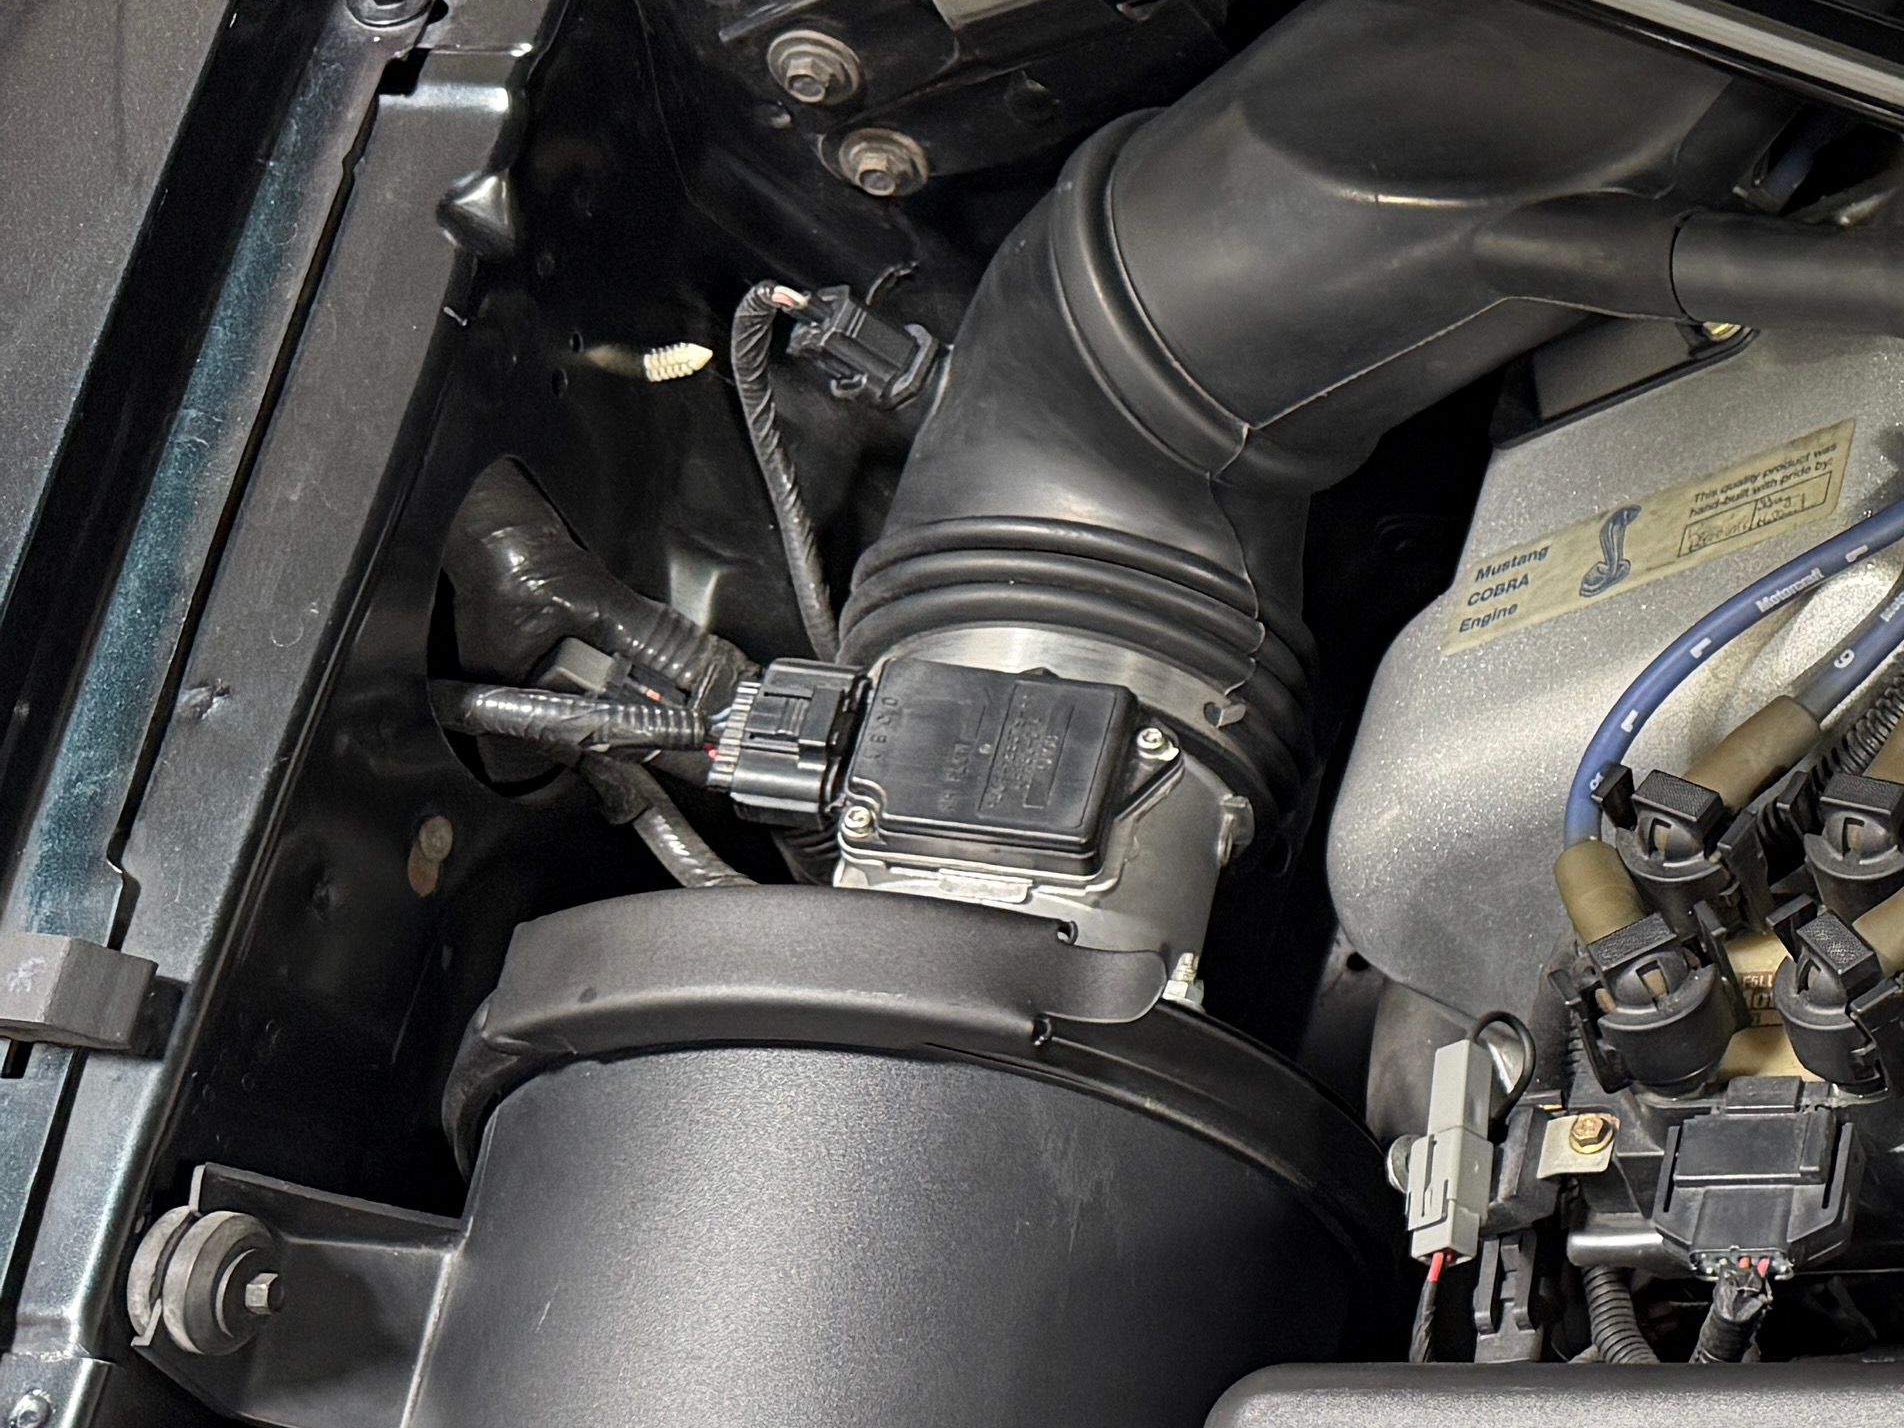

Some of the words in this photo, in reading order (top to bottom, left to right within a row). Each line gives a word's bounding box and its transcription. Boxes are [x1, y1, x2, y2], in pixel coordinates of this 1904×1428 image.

[1720, 471, 1760, 496] quality
[1761, 454, 1811, 483] product
[1812, 442, 1838, 460] was
[1687, 492, 1751, 519] hand-built
[1751, 479, 1779, 498] with
[1778, 464, 1812, 490] pride
[1474, 544, 1550, 582] Mustang
[1466, 574, 1531, 607] COBRA
[1755, 567, 1825, 613] Motorcraft
[1458, 602, 1519, 633] Engine
